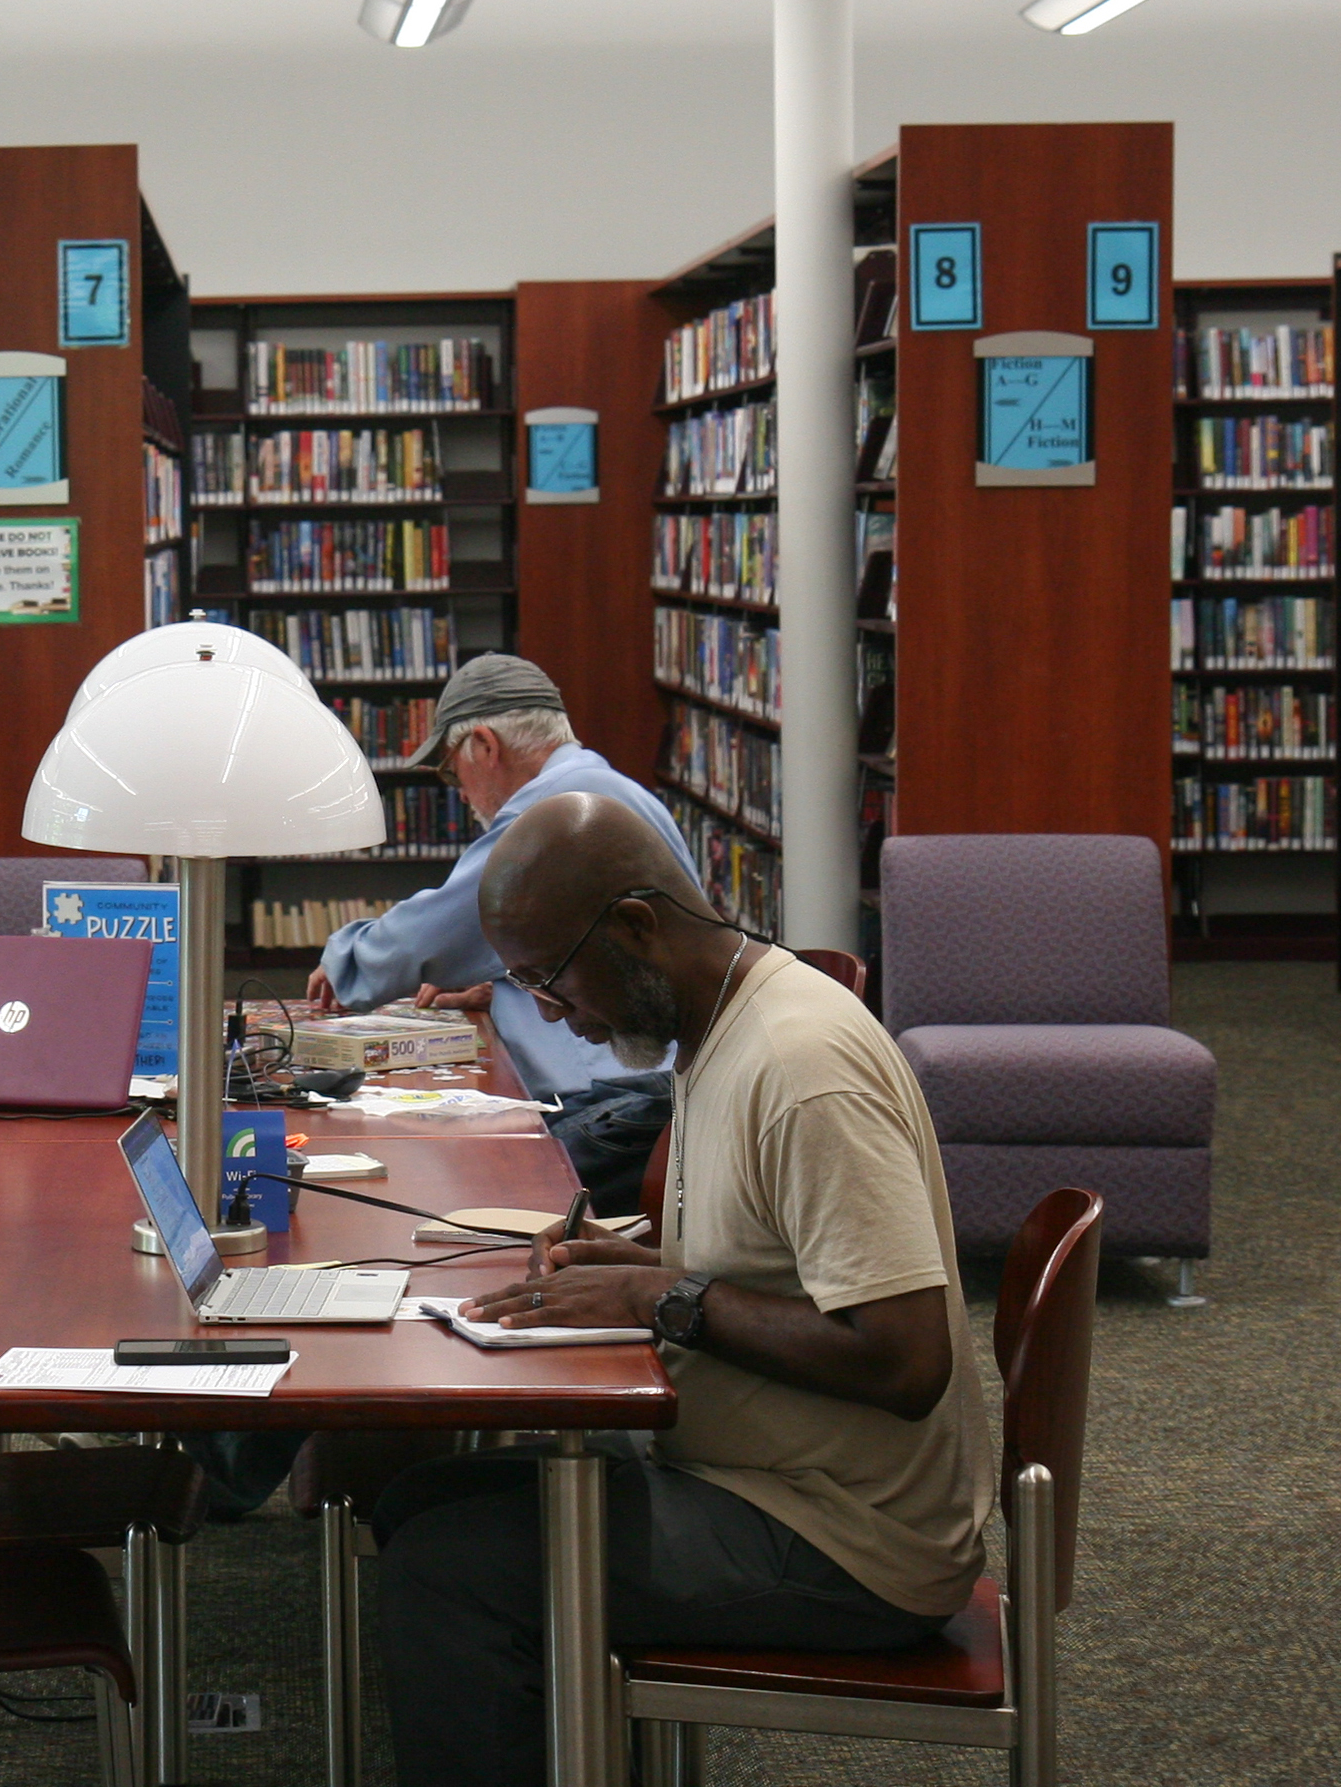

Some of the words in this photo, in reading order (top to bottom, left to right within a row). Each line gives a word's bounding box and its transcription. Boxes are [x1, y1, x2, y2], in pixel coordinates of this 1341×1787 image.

[935, 256, 957, 289] 8
[1111, 263, 1132, 296] 9
[84, 274, 103, 305] 7
[991, 357, 1042, 370] Fiction
[1028, 436, 1080, 448] Fiction
[4, 422, 53, 479] Romance
[8, 532, 26, 542] DO
[29, 531, 52, 541] NOT
[4, 564, 33, 575] them
[35, 566, 50, 574] on
[10, 580, 55, 591] Thanks!
[97, 901, 168, 911] COMMUNITY
[86, 915, 177, 943] PUZZLE
[3, 1001, 26, 1031] hp
[391, 1040, 415, 1056] 500
